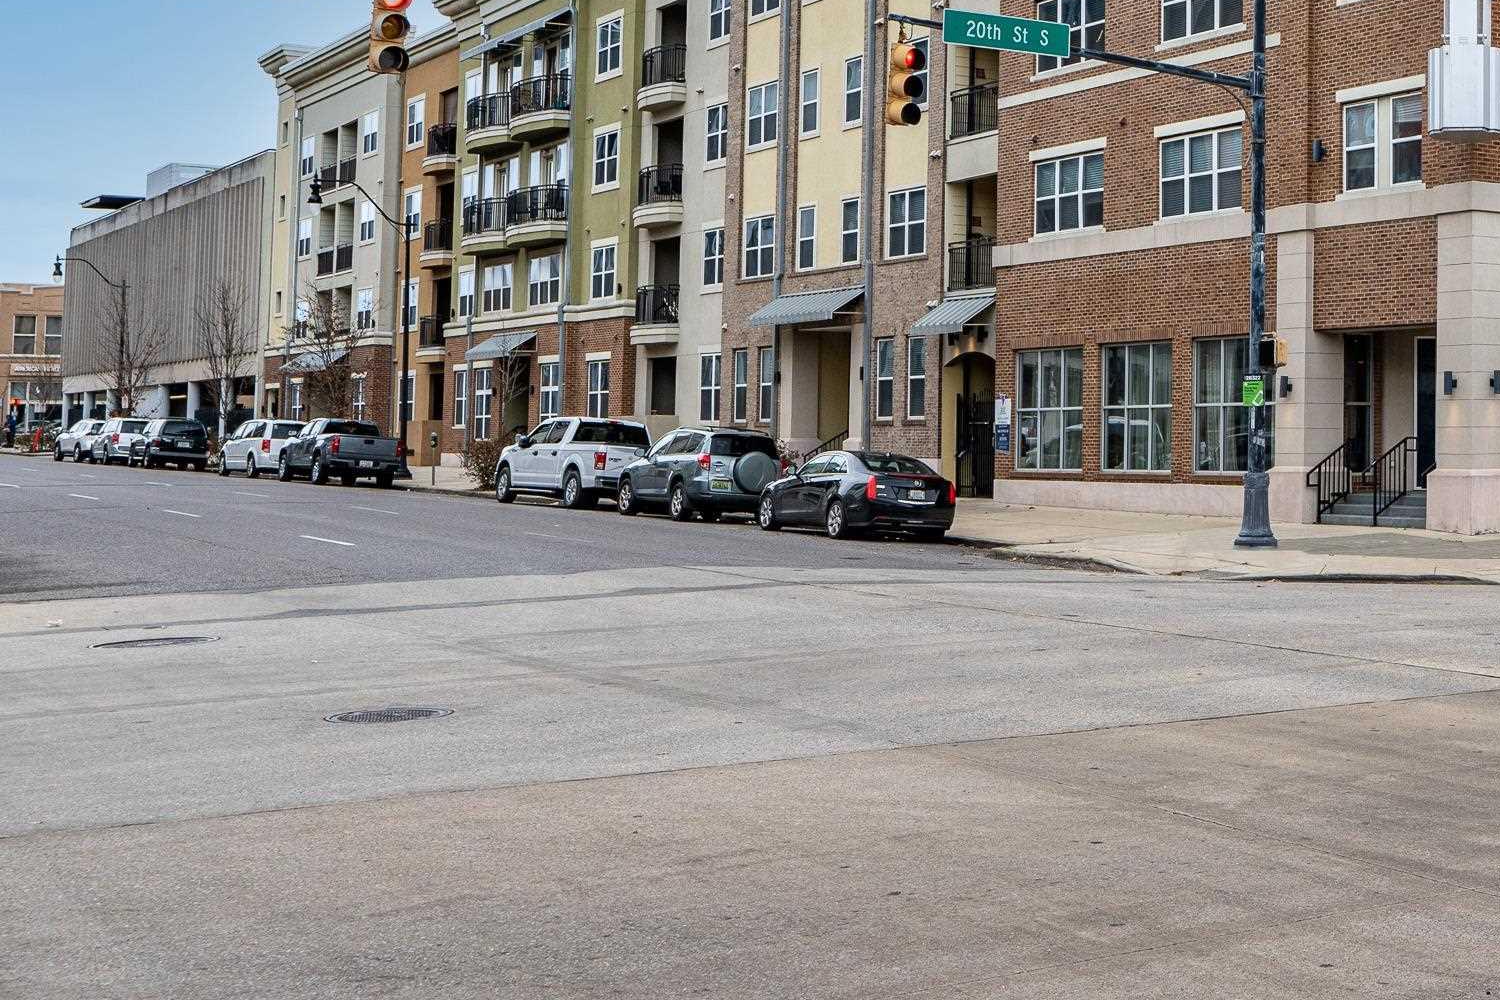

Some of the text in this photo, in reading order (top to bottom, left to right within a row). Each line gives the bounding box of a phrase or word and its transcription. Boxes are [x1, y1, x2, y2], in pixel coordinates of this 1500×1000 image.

[966, 20, 1049, 47] 20th St S
